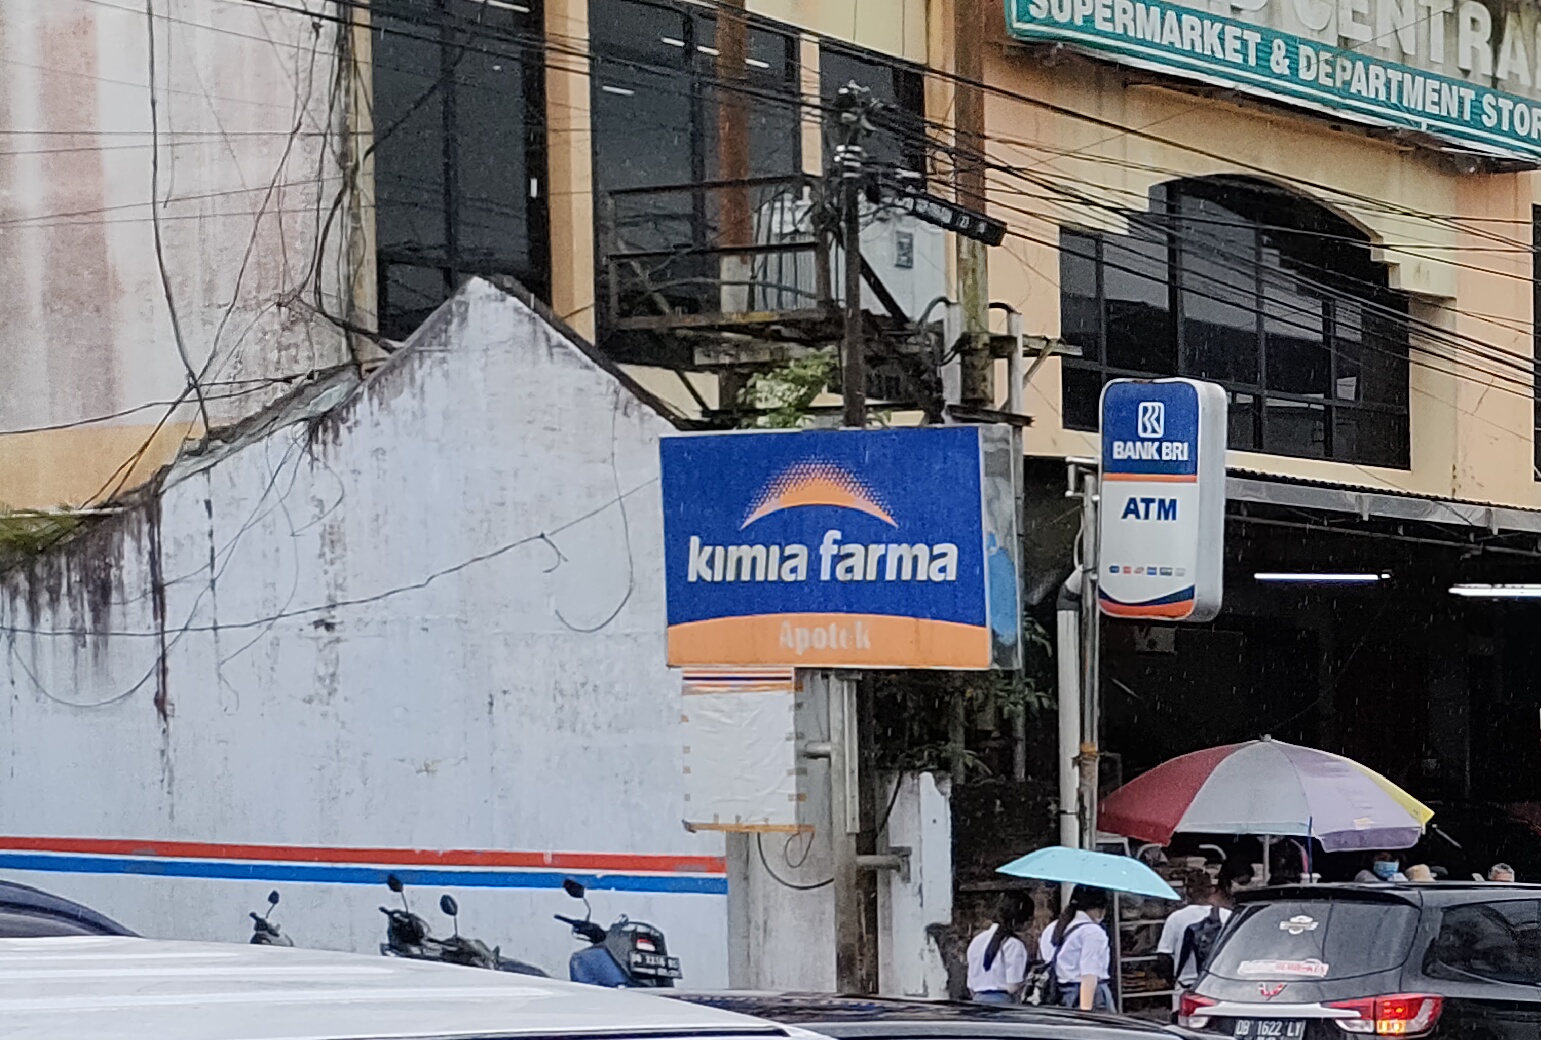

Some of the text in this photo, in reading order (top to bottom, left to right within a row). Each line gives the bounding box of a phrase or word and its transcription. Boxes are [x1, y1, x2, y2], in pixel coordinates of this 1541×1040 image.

[1028, 0, 1261, 66] SUPERMARKET
[1269, 38, 1291, 77] &
[1298, 44, 1476, 121] DEPARTMENT
[1112, 440, 1190, 462] BANK BRI
[1121, 497, 1178, 521] ATM
[819, 529, 958, 583] farma
[778, 619, 872, 656] Apotek
[1236, 1019, 1250, 1036] DB
[1257, 1020, 1283, 1036] 1622
